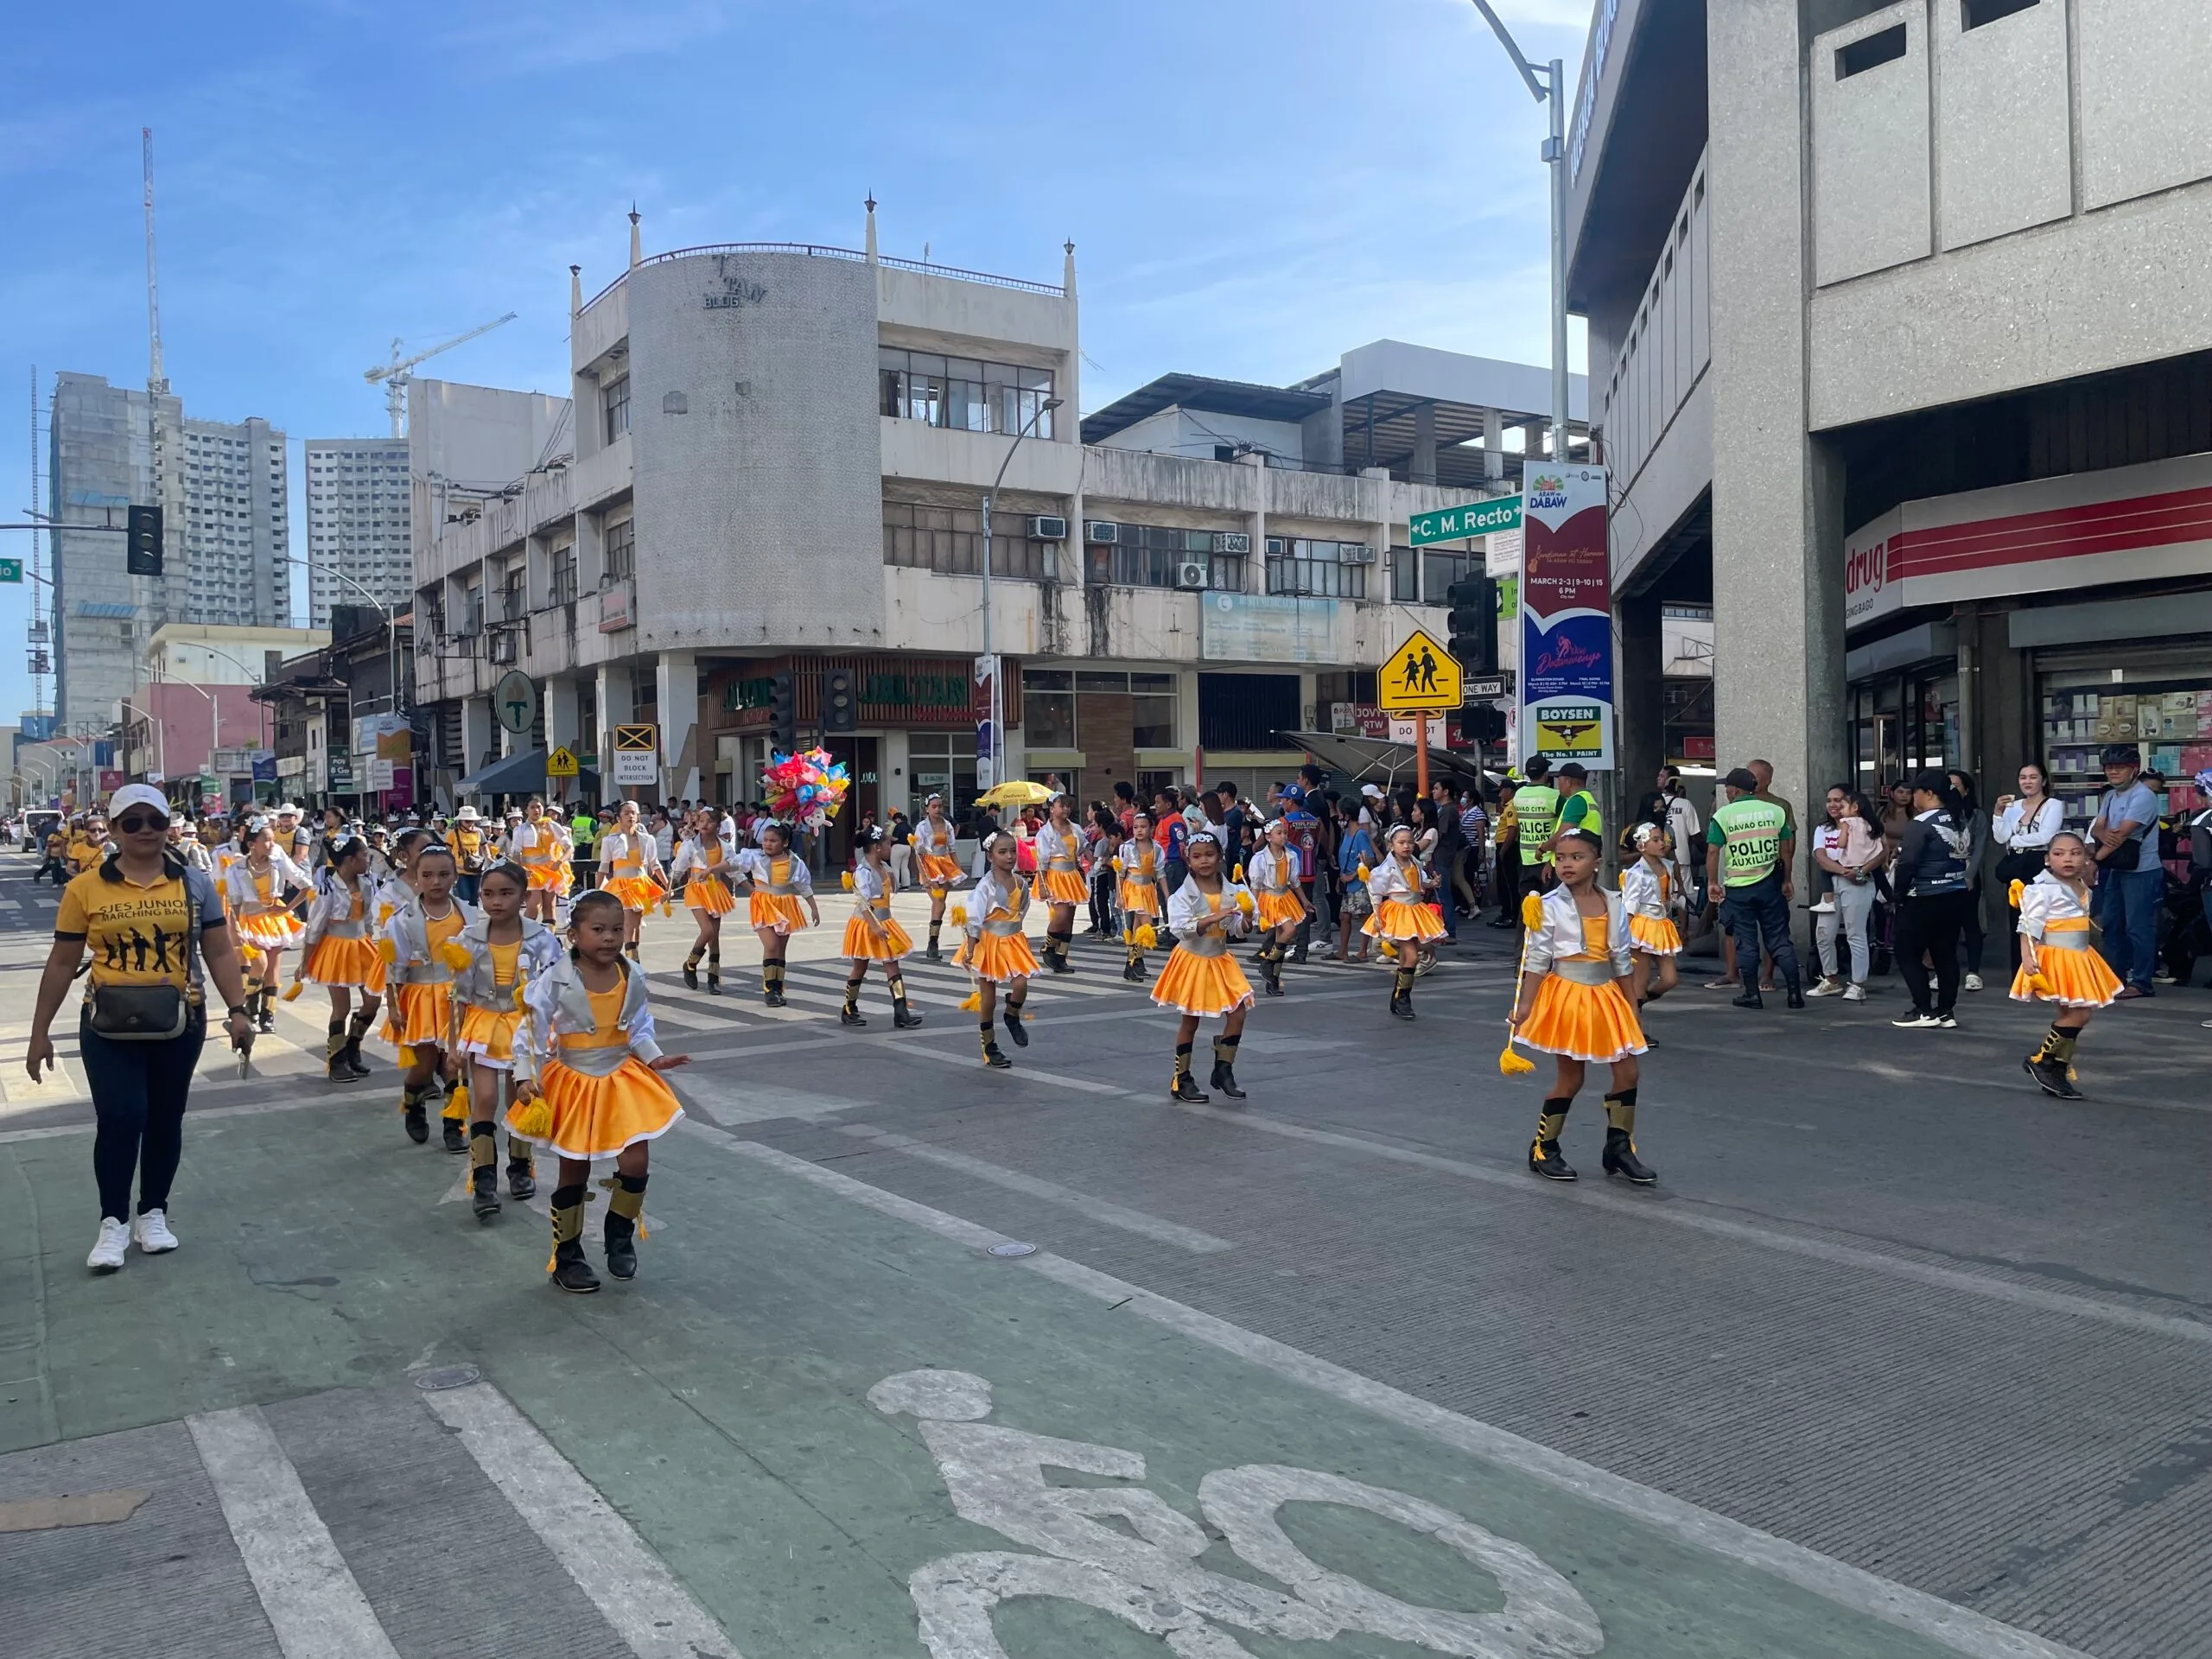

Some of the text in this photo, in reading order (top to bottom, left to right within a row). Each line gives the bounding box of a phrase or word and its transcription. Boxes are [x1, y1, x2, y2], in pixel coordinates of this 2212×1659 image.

[1530, 497, 1567, 508] DABAW
[1421, 506, 1512, 536] C. M. Recto
[1846, 543, 1884, 594] drug
[1462, 683, 1498, 695] ONE WAY
[1541, 709, 1593, 721] BOYSEN
[1363, 721, 1383, 729] RTW
[1399, 727, 1413, 735] DO
[1728, 822, 1756, 832] DAVAO
[1728, 839, 1780, 858] POLICE
[99, 902, 132, 914] SJES
[164, 907, 188, 917] BAN
[102, 909, 162, 922] MARCHING
